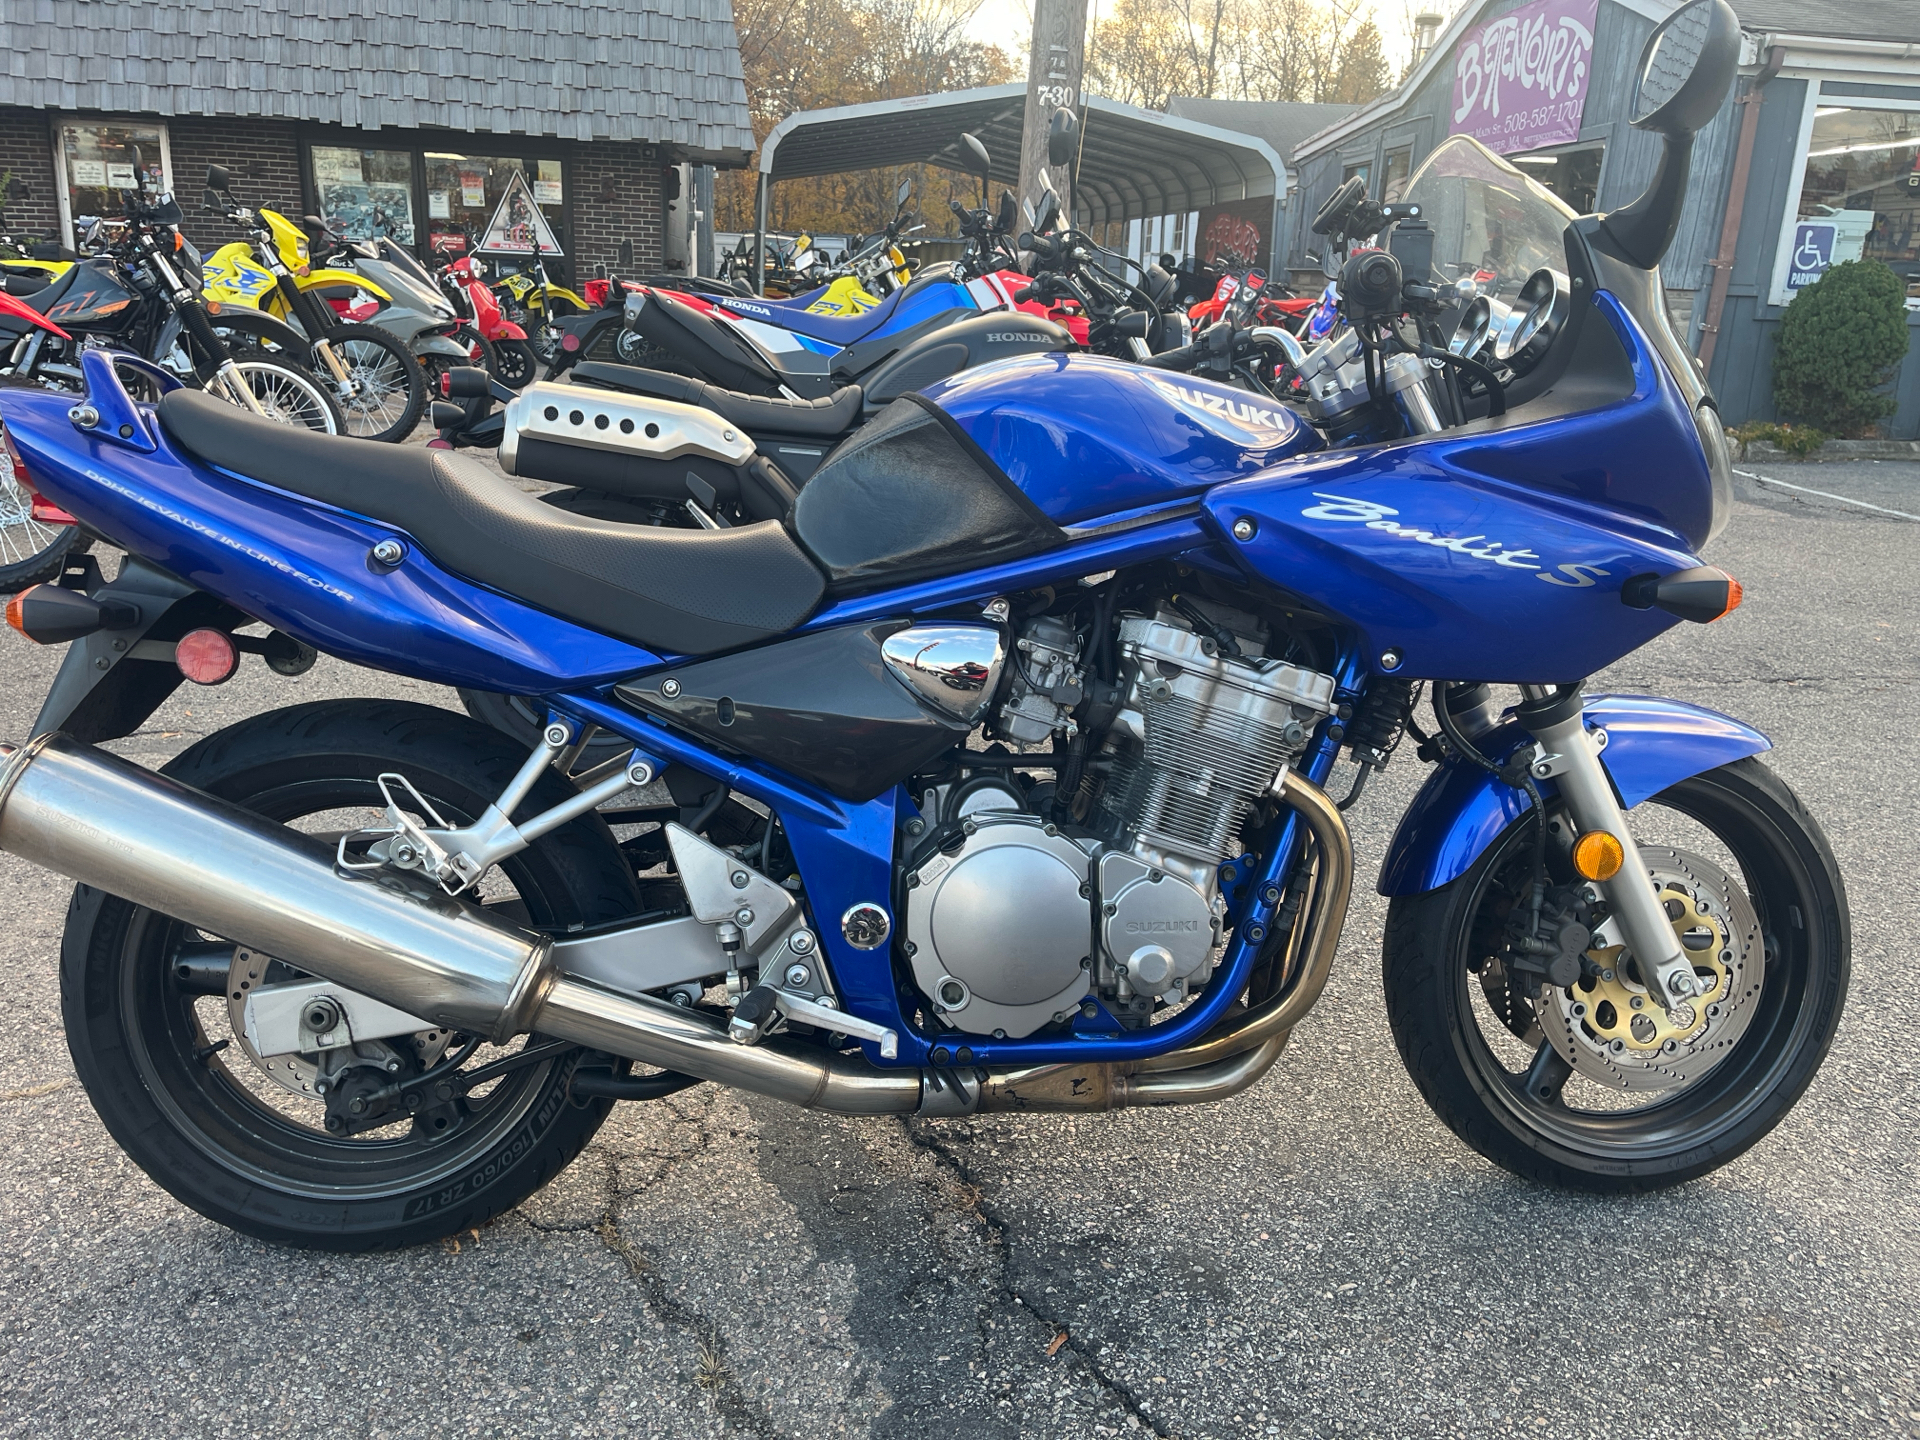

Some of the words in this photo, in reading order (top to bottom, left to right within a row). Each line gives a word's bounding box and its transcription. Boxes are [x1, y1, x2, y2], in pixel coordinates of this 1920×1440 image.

[1037, 85, 1073, 107] 7-30
[1504, 98, 1584, 134] 508-587-1701
[722, 298, 771, 316] HONDA
[986, 333, 1054, 344] HONDA
[1154, 380, 1287, 431] SUZUKI
[85, 469, 137, 500] DOHC
[292, 570, 355, 602] FOUR
[1301, 492, 1541, 569] Bandit
[1535, 563, 1611, 588] S
[37, 806, 100, 840] SUZUKI
[1126, 921, 1198, 934] SUZUKI
[471, 1135, 529, 1187] 160/60
[411, 1196, 434, 1216] 17
[440, 1181, 465, 1204] ZR
